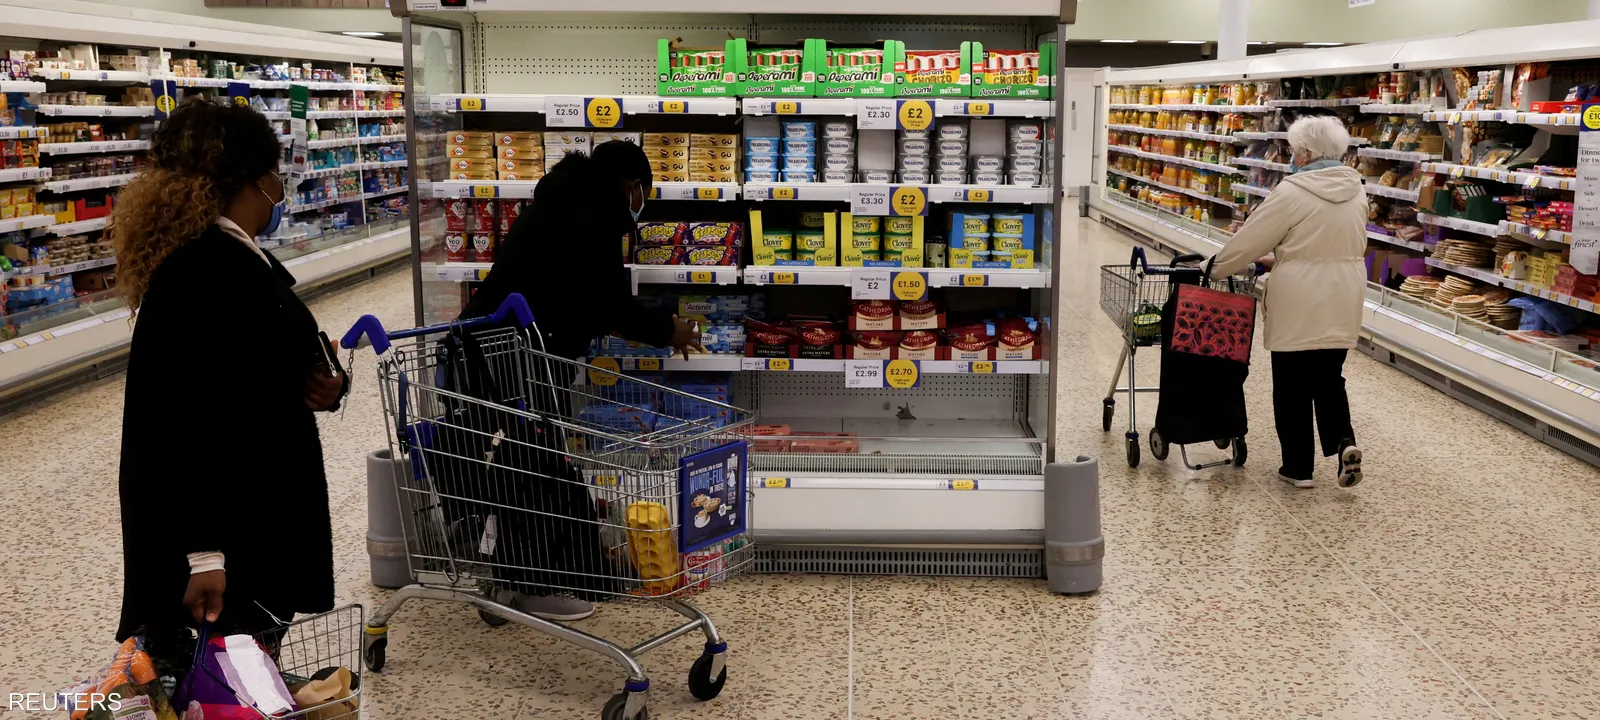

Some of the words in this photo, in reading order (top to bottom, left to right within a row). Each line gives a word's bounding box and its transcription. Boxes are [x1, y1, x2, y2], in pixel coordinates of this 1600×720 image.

[672, 68, 722, 82] Peperami
[748, 68, 797, 82] Peperami
[828, 68, 878, 82] Peperami
[912, 75, 952, 84] CHORIZO
[993, 76, 1034, 84] CHORIZO
[667, 84, 696, 93] Peperami
[746, 84, 774, 93] Peperami
[825, 84, 854, 94] Peperami
[901, 85, 933, 95] Peperami
[979, 86, 1011, 96] Peperami
[596, 106, 611, 116] £2
[908, 108, 923, 118] £2
[901, 195, 915, 205] £2
[852, 221, 872, 229] Clover
[892, 221, 912, 229] Clover
[963, 222, 982, 230] Clover
[763, 239, 783, 247] Clover
[852, 239, 872, 247] Clover
[892, 239, 912, 247] Clover
[963, 240, 982, 248] Clover
[1572, 240, 1595, 249] finest
[756, 252, 773, 260] Clover
[817, 254, 834, 262] Clover
[844, 254, 861, 263] Clover
[904, 254, 921, 262] Clover
[859, 304, 892, 314] CATHEDRAL
[901, 302, 933, 311] CATHEDRAL
[904, 334, 933, 345] CATHEDRAL
[1002, 333, 1032, 343] CATHEDRAL
[954, 341, 986, 349] CATHEDRAL
